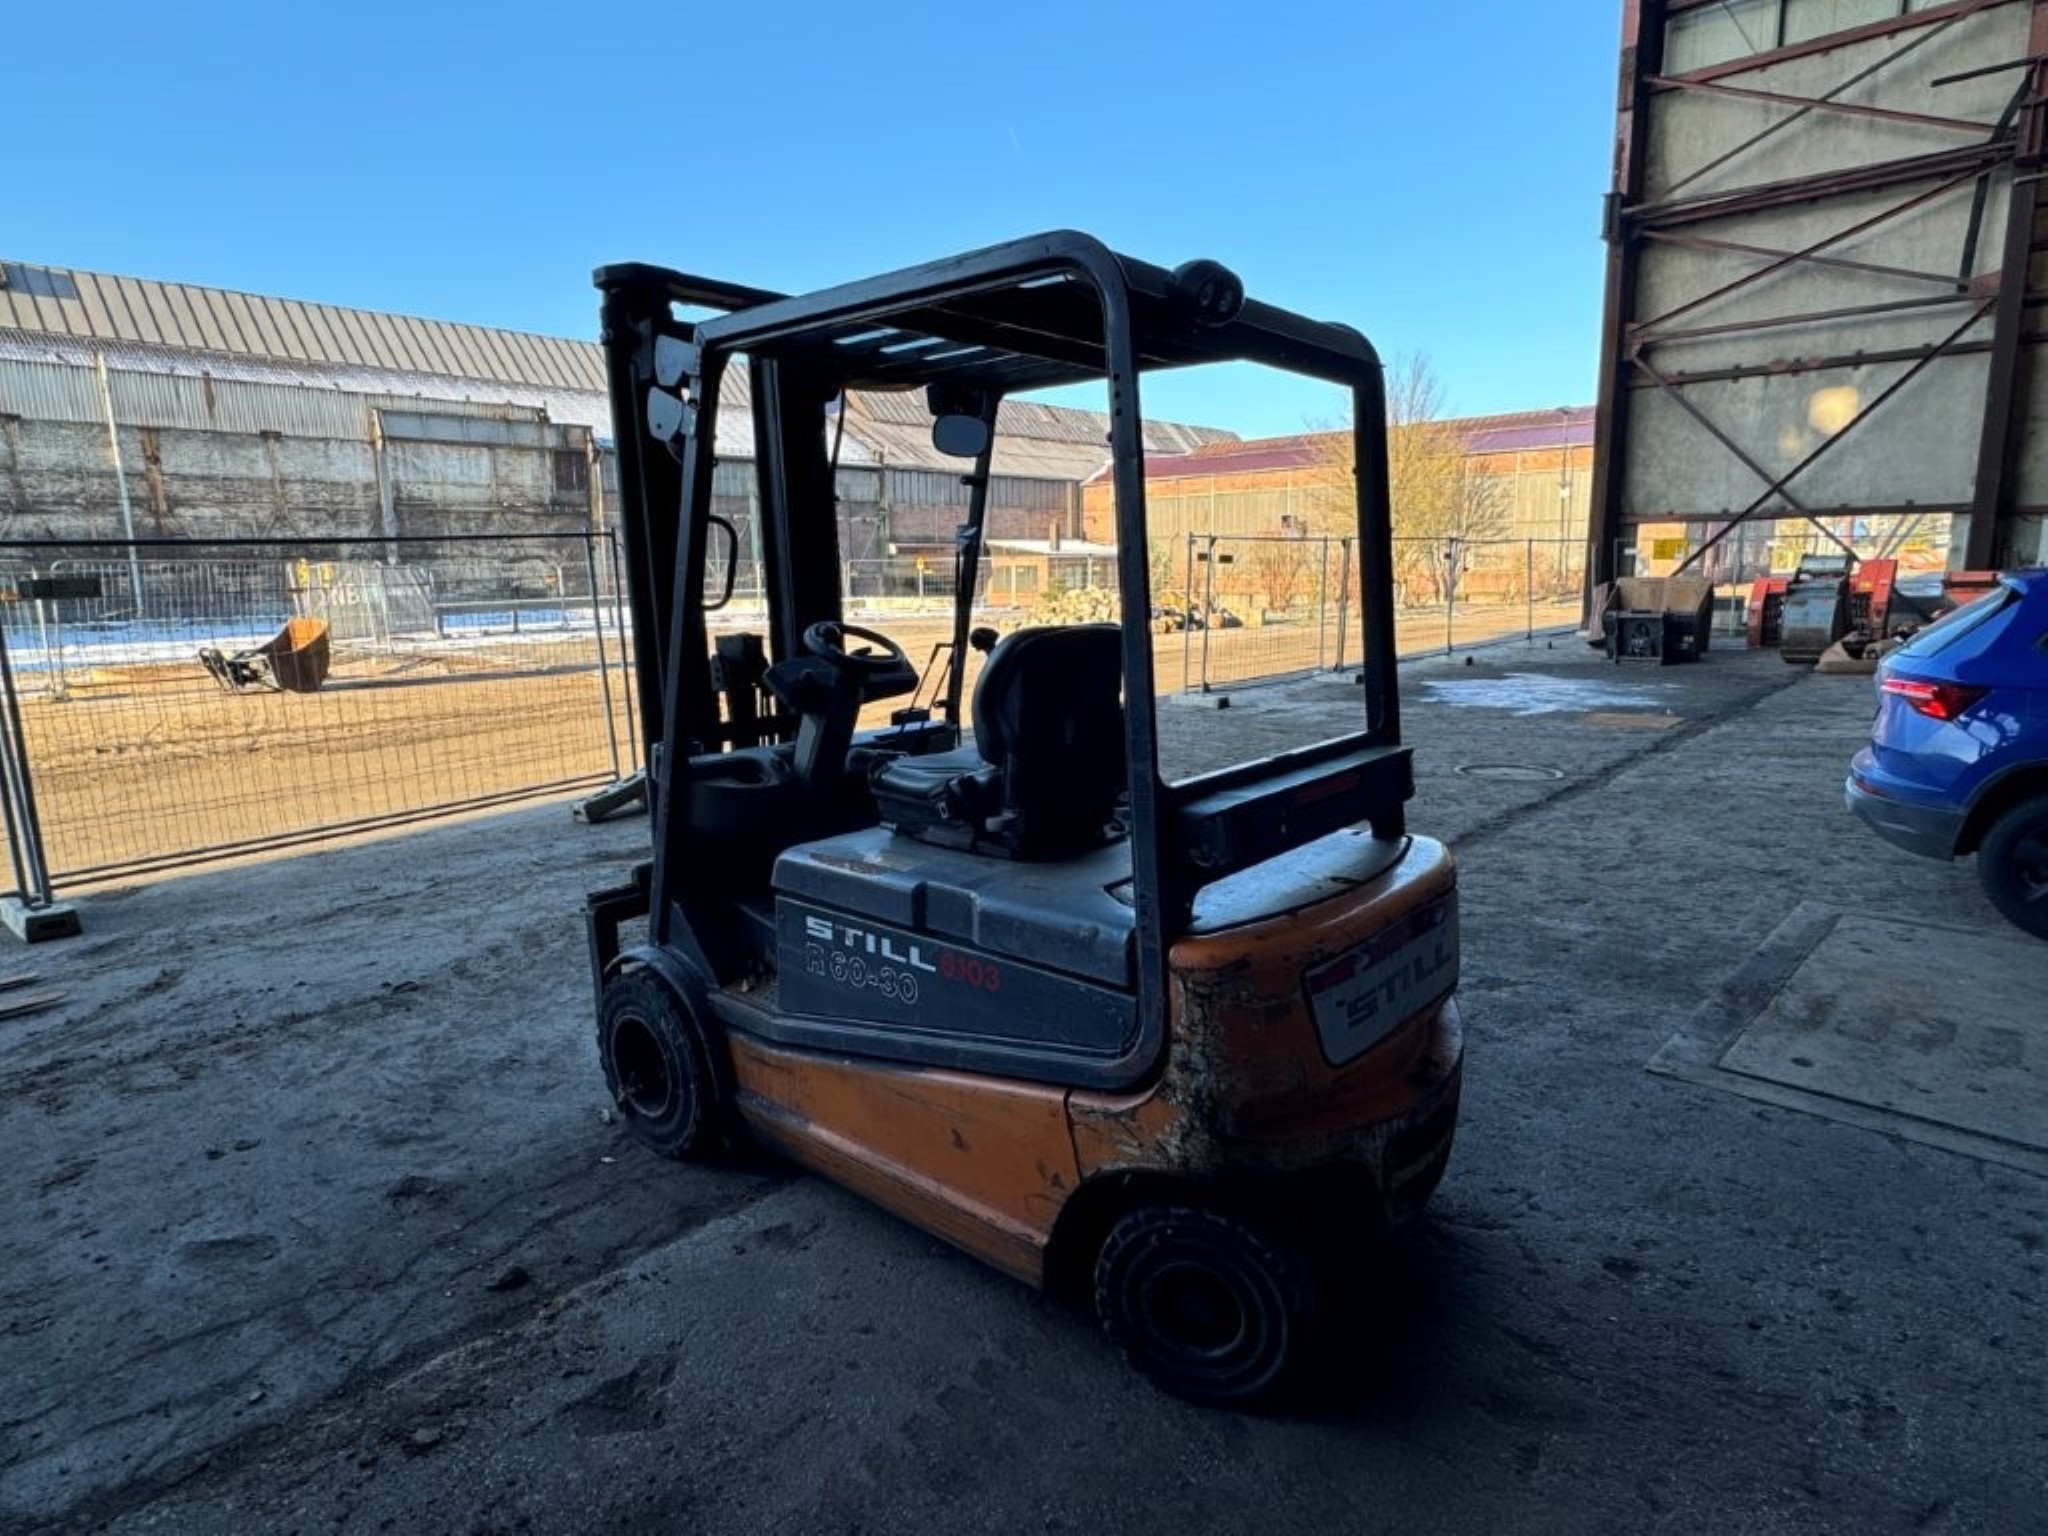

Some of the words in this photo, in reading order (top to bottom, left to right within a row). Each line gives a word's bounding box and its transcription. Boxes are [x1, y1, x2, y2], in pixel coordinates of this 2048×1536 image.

[805, 915, 937, 973] STILL
[805, 941, 827, 977] R
[829, 951, 919, 1005] 60-30
[1347, 942, 1452, 1027] STILL
